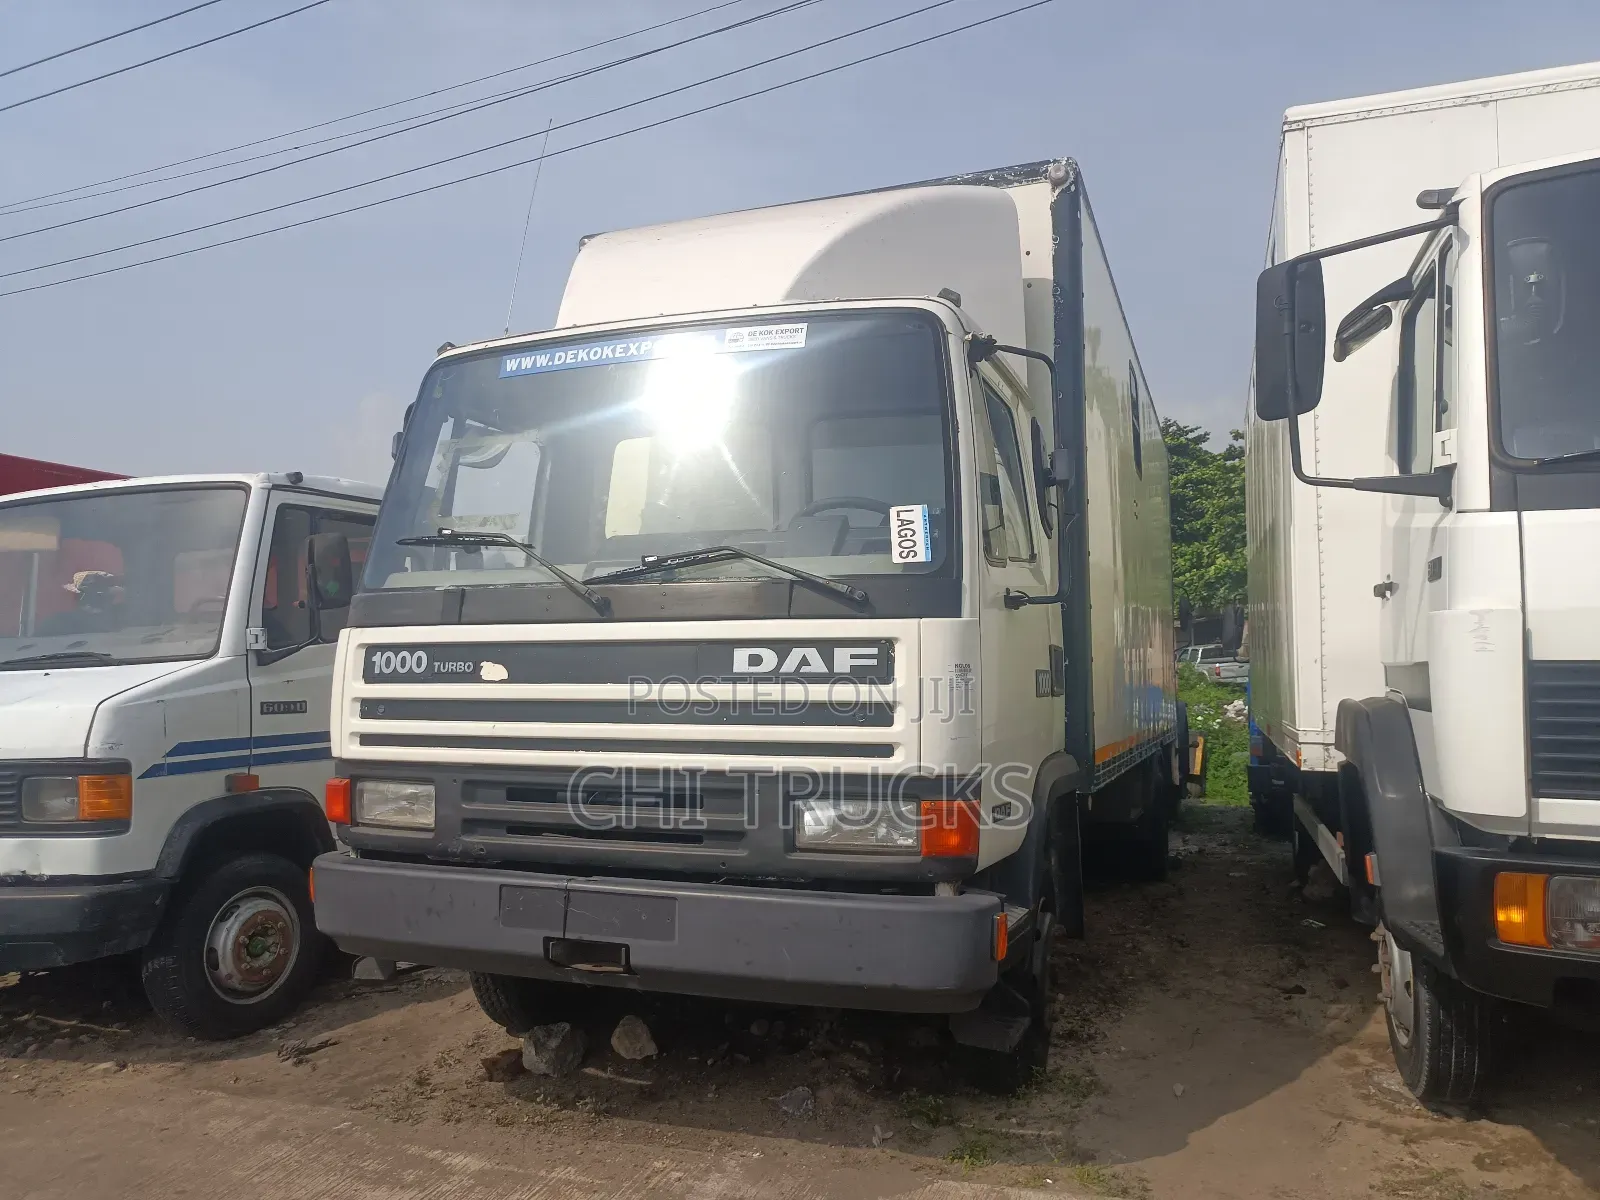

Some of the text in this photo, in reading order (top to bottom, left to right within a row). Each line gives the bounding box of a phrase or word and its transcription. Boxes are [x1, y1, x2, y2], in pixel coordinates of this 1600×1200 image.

[759, 329, 774, 337] KOK
[775, 327, 805, 336] EXPORT
[505, 340, 658, 372] WWW.DEKOKEXP
[896, 509, 918, 560] LAGOS
[371, 650, 474, 675] 1000 TURBO
[732, 646, 879, 674] DAF
